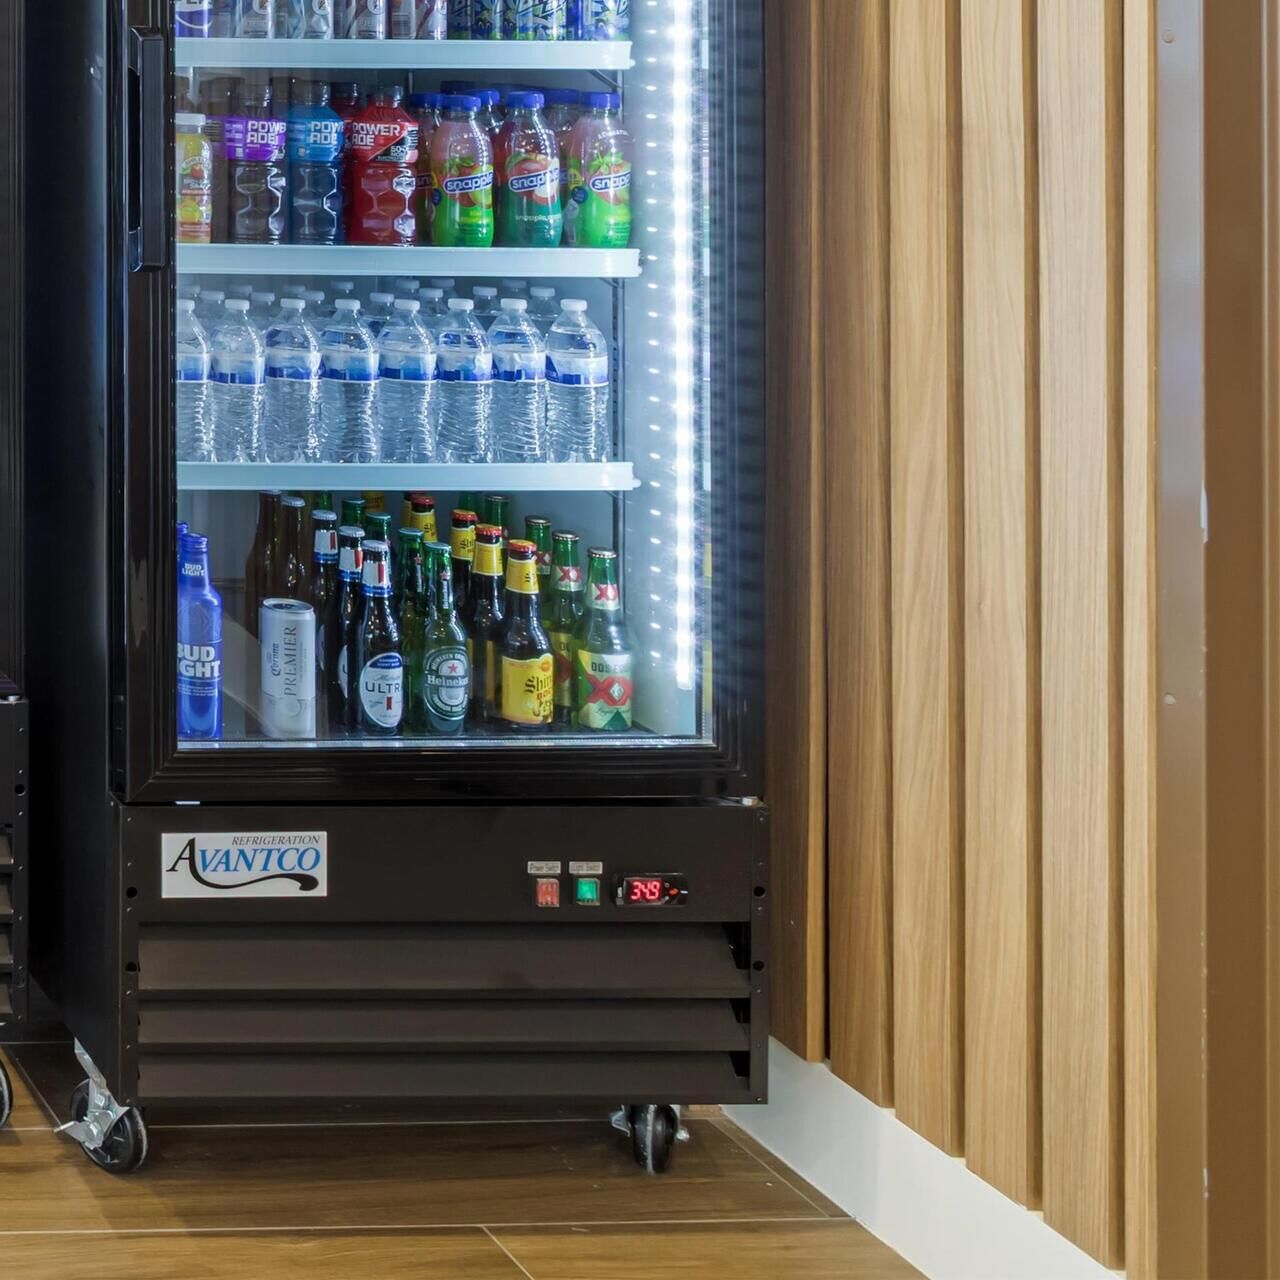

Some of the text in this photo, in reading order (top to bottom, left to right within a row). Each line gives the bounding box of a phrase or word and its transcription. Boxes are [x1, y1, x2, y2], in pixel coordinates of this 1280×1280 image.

[353, 122, 400, 136] POWER
[352, 134, 375, 146] ADE
[447, 172, 493, 191] snapple
[511, 169, 559, 190] snapple
[594, 173, 631, 191] snapp
[181, 569, 205, 577] LIGHT
[184, 563, 202, 571] BUD
[270, 643, 281, 677] Corona
[284, 626, 297, 696] PREMIER
[365, 681, 400, 694] ULTR
[523, 674, 552, 694] Shin
[232, 835, 320, 846] REFRIGERATION
[166, 837, 321, 882] AVANTCO
